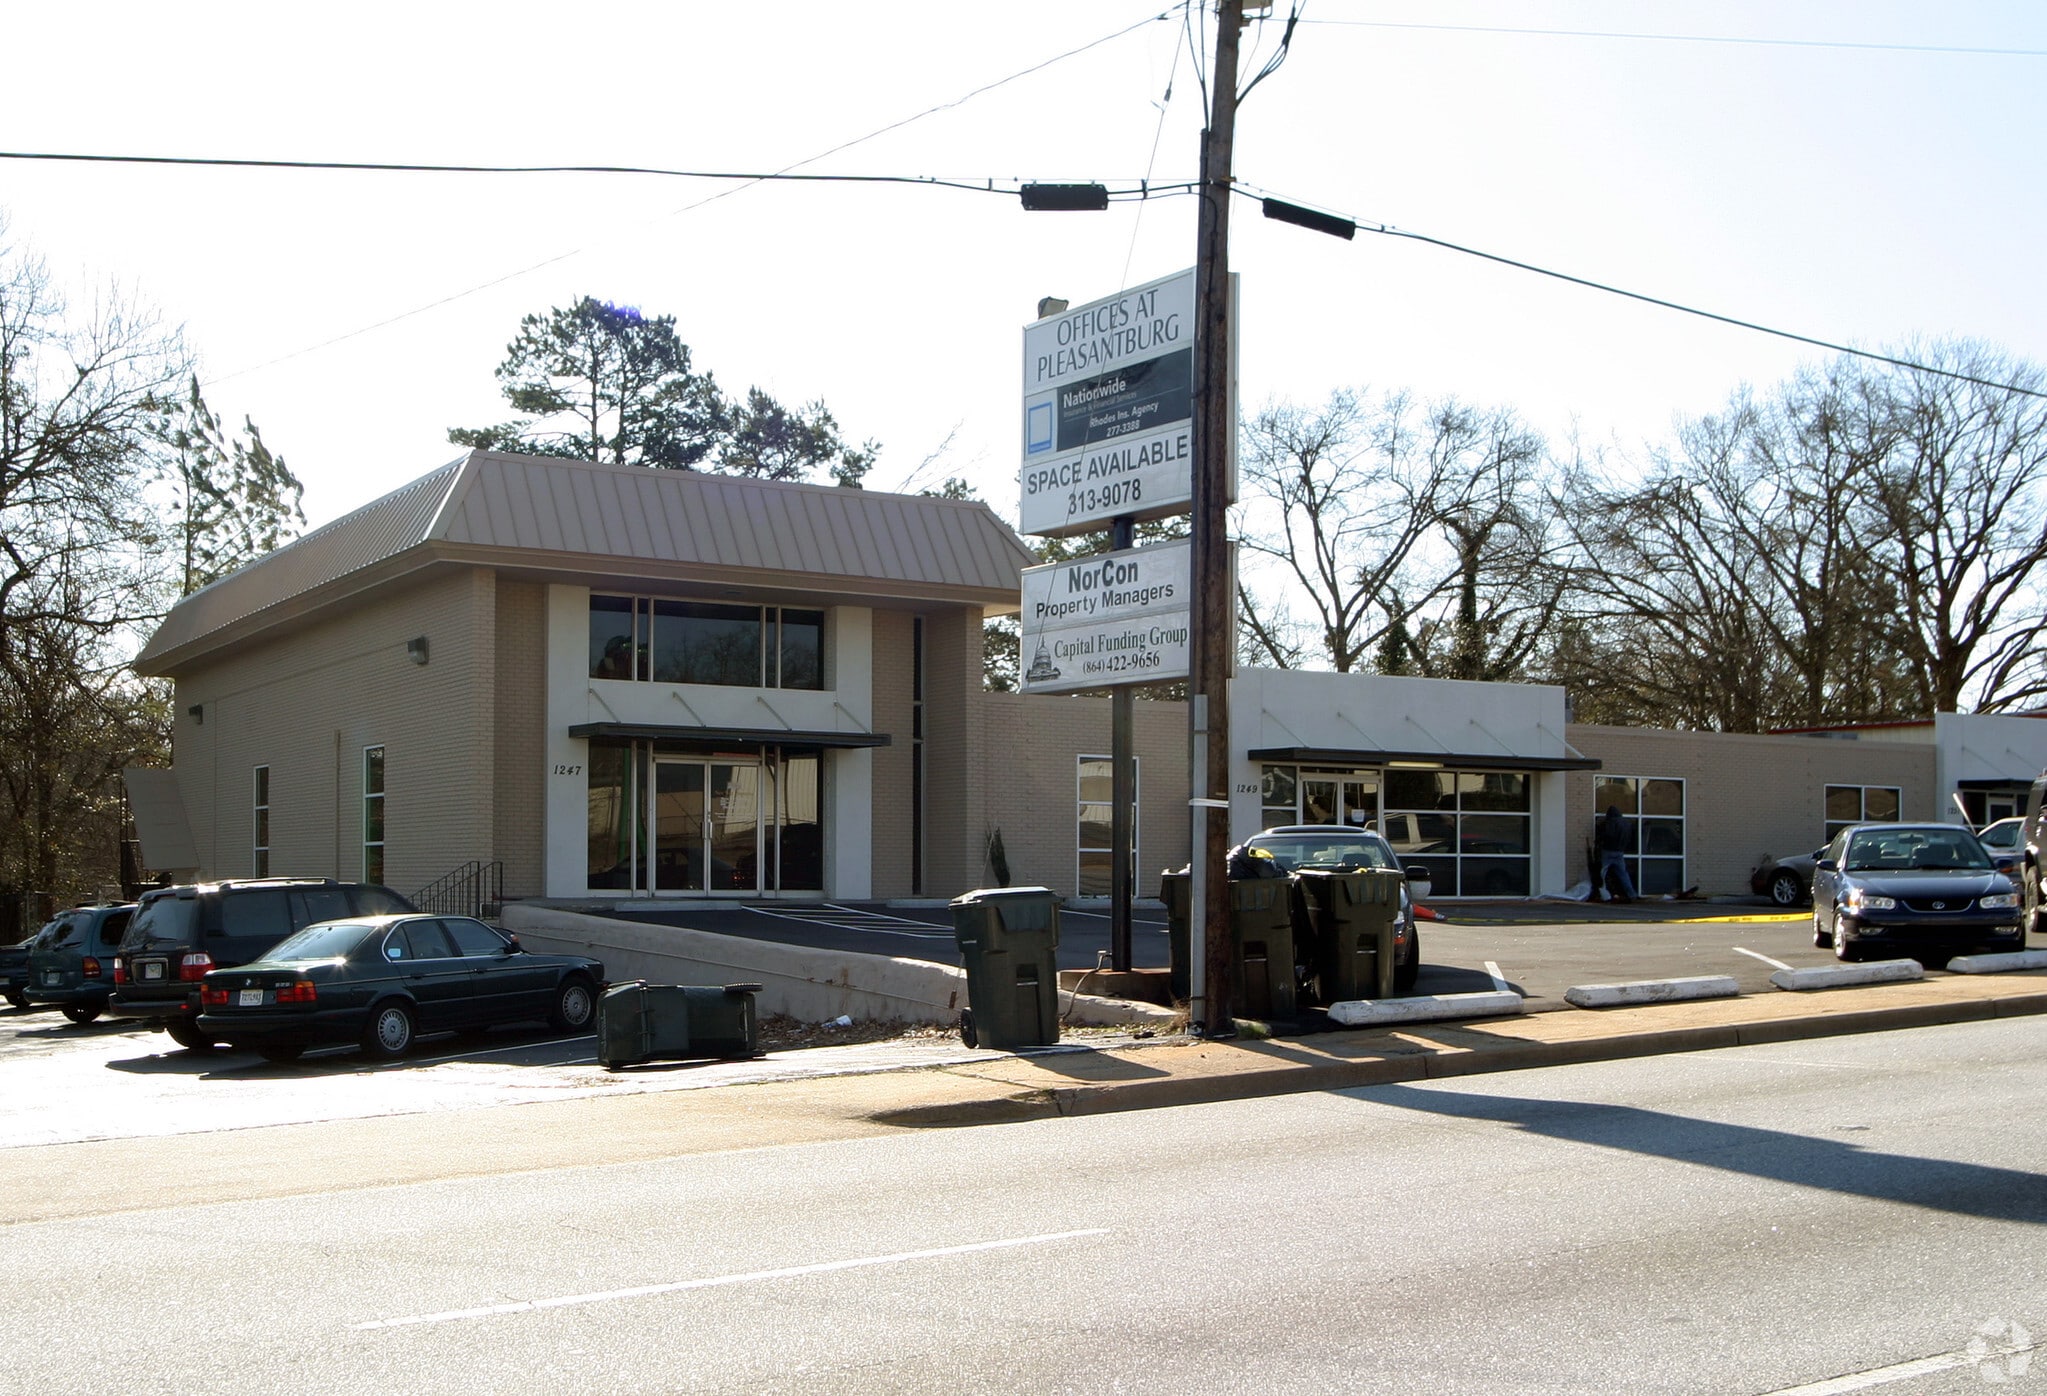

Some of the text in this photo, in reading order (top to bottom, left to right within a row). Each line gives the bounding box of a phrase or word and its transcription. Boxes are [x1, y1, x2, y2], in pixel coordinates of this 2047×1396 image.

[1057, 289, 1159, 346] OFFICES AT
[1038, 314, 1179, 382] PLEASANTBURG
[1063, 377, 1126, 408] Nationwide
[1090, 402, 1159, 428] Rhodes Ins. Agency
[1027, 435, 1188, 495] SPACE AVAILABLE
[1069, 478, 1141, 515] 313-9078
[1068, 560, 1138, 593] NorCon
[1036, 584, 1174, 619] Property Managers
[1054, 626, 1188, 661] Capital Funding Group
[1106, 651, 1160, 673] 422-9656
[554, 764, 582, 776] 1247
[1237, 784, 1258, 794] 1249
